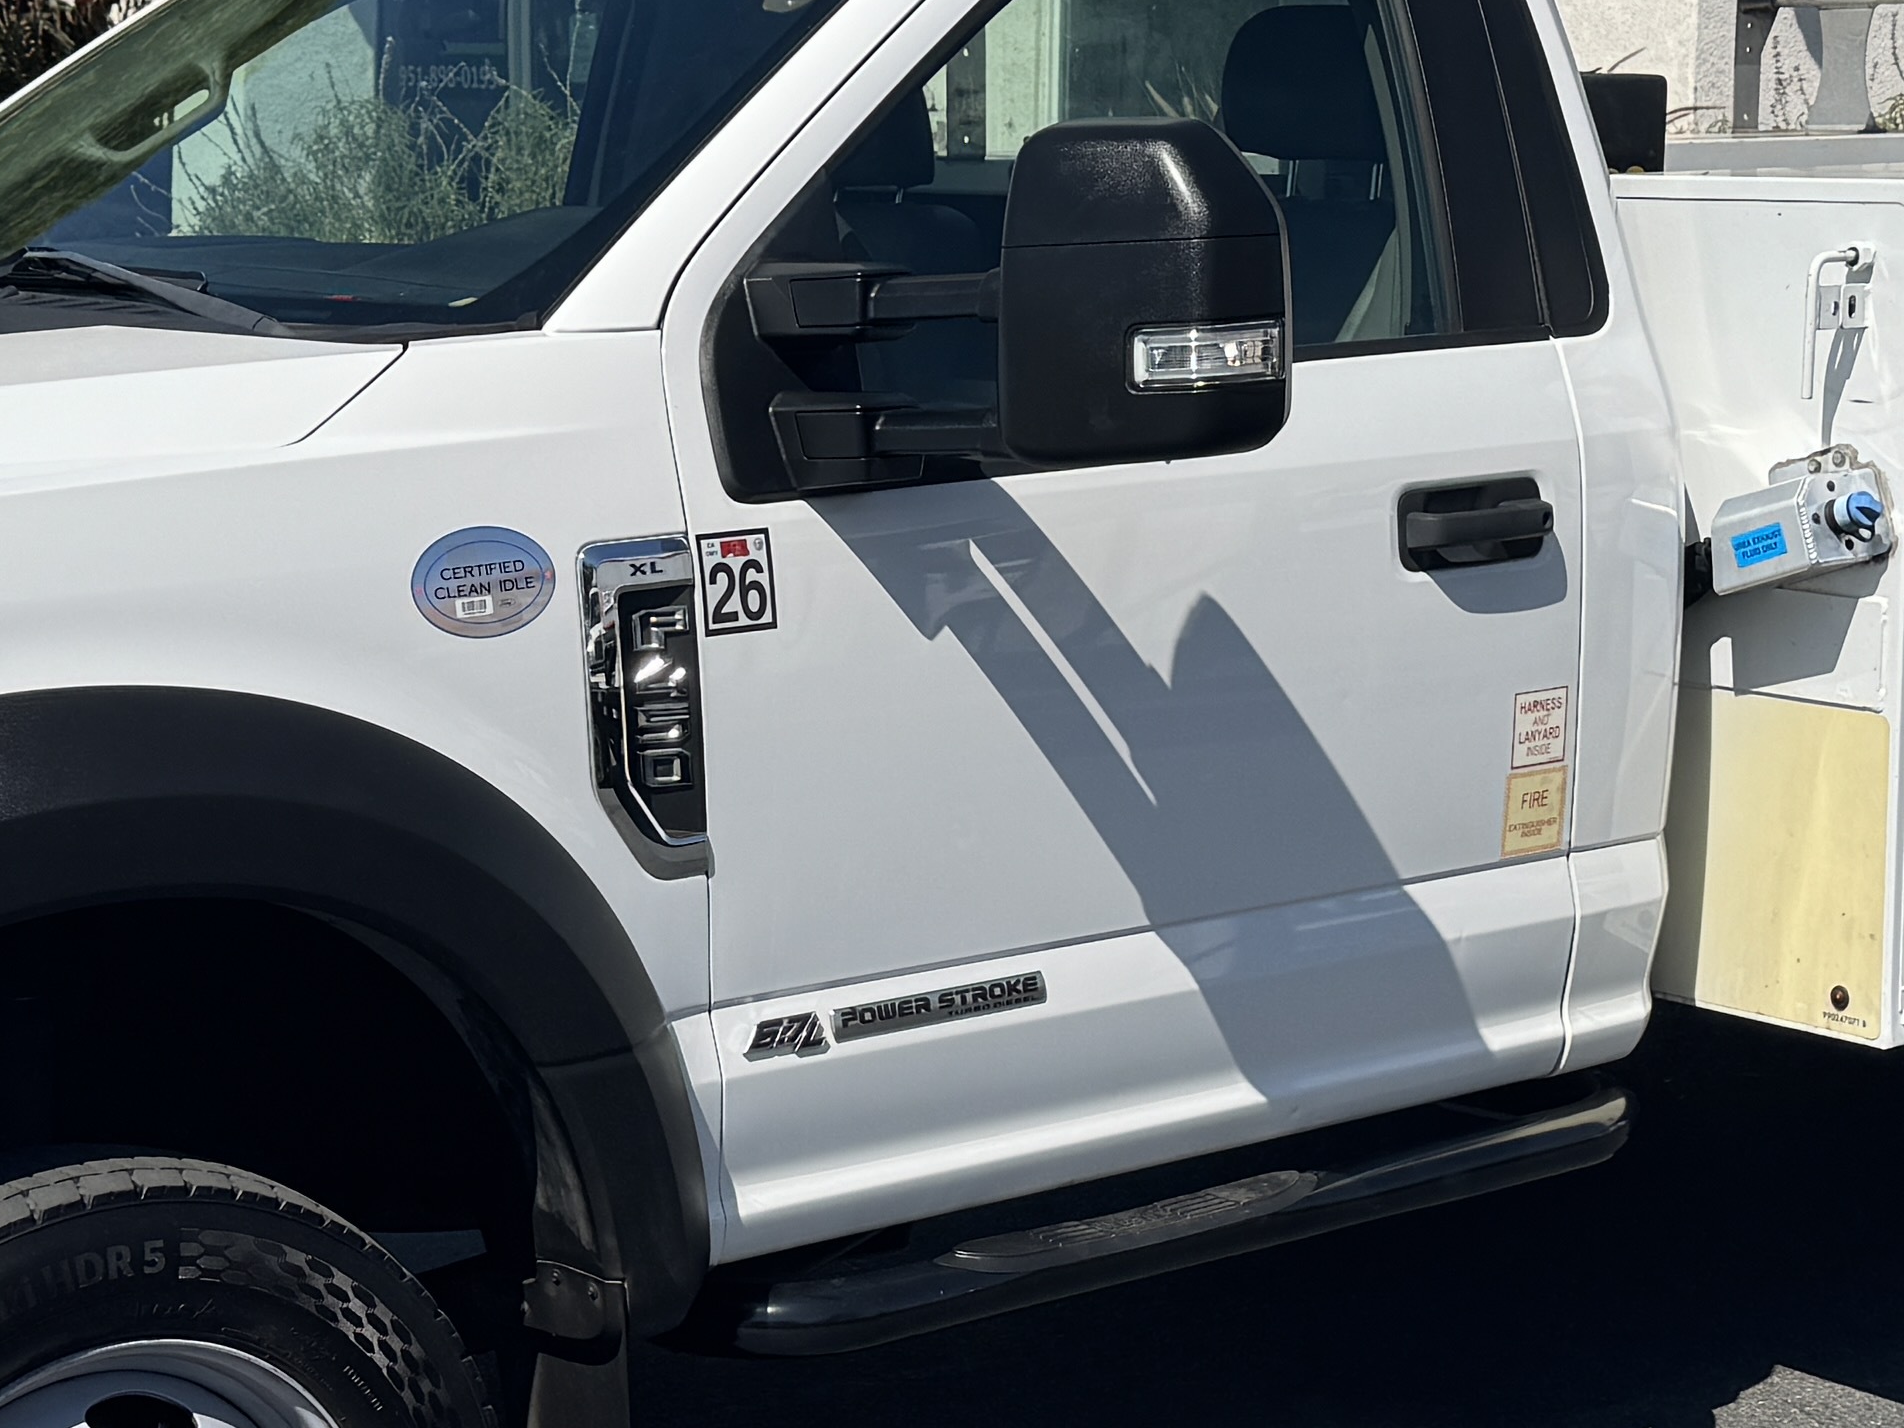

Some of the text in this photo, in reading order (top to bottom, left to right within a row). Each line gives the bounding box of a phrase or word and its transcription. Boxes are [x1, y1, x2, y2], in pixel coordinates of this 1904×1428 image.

[440, 559, 525, 581] CERTIFIED
[629, 562, 663, 577] XL
[434, 576, 536, 600] CLEAN IDLE
[709, 559, 767, 624] 26
[1520, 696, 1562, 715] HARNESS
[1532, 714, 1552, 727] AND
[1518, 725, 1561, 745] LANYARD
[1526, 743, 1551, 757] INSIDE
[1521, 789, 1549, 810] FIRE
[840, 996, 932, 1029] POWER
[938, 975, 1039, 1010] STROKE
[948, 995, 1040, 1016] TURBO DIESEL
[43, 1245, 135, 1296] HDR
[142, 1239, 166, 1274] 5
